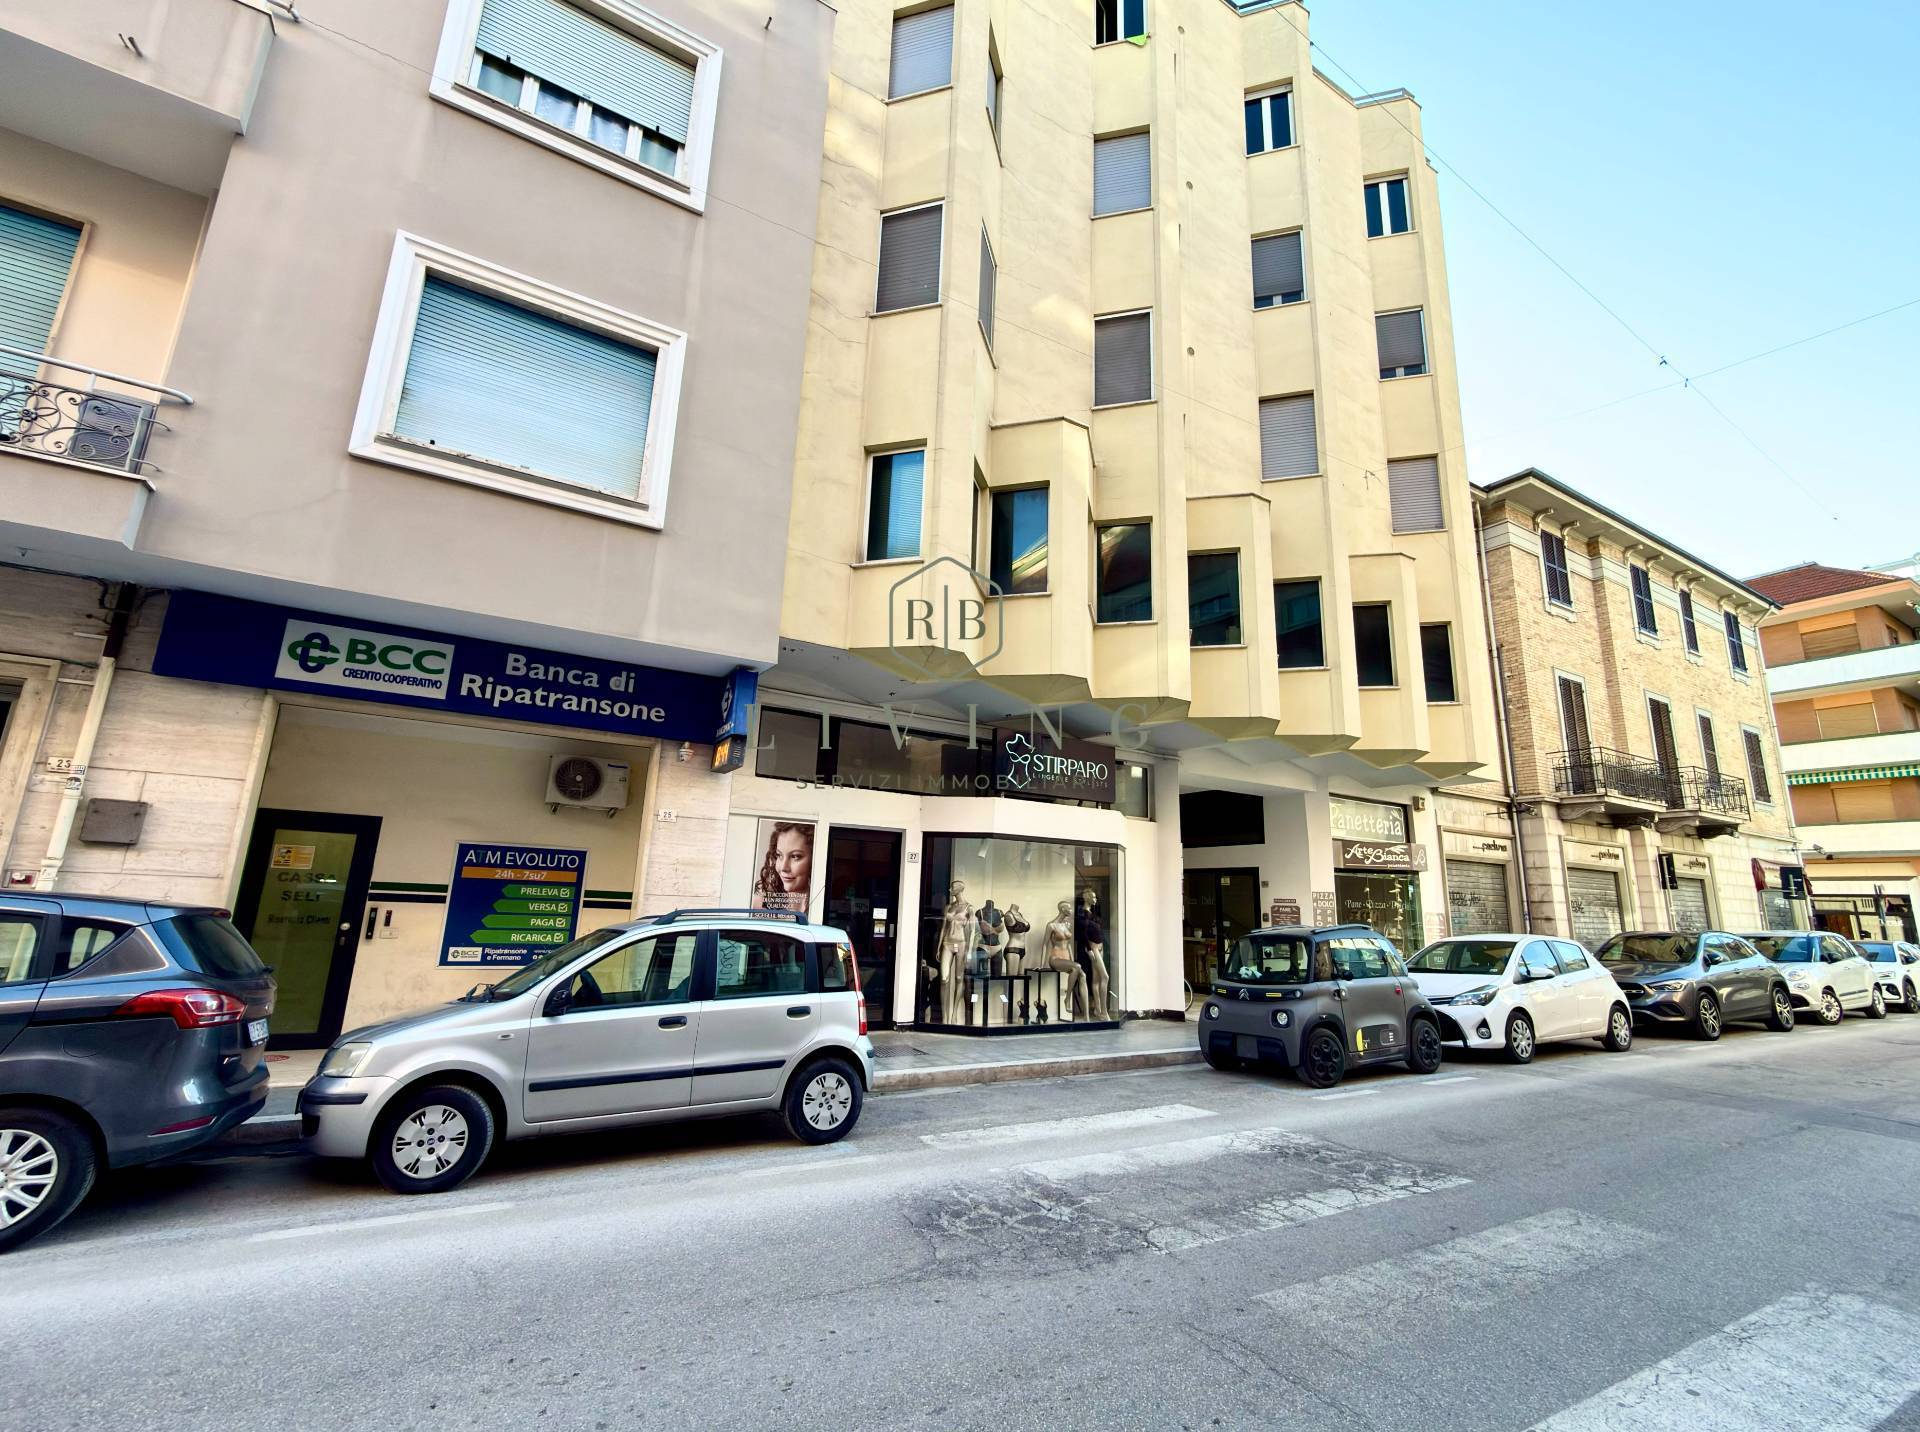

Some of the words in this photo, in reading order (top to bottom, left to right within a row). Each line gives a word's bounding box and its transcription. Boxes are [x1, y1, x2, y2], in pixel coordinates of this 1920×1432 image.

[345, 638, 447, 675] BCC
[505, 652, 600, 689] Banca
[609, 669, 636, 693] di
[343, 667, 382, 683] CREDITO
[382, 673, 443, 690] COOPERATIVO
[460, 673, 666, 723] Ripatransone
[57, 759, 72, 769] 23
[1033, 753, 1108, 781] STIRPARO
[663, 811, 672, 819] 25
[1329, 804, 1403, 836] Panetteria
[465, 849, 501, 865] ATM
[506, 851, 579, 869] EVOLUTO
[1345, 843, 1374, 859] Arte
[1365, 849, 1410, 865] Bianca
[495, 869, 514, 879] 24h
[523, 871, 547, 881] 7su7
[520, 887, 559, 896] PRELEVA
[1312, 892, 1334, 900] PIZZA
[528, 902, 556, 912] VERSA
[1317, 900, 1335, 908] DOLCI
[1345, 901, 1362, 909] Pane
[530, 918, 554, 927] PAGA
[511, 933, 552, 943] RICARICA
[484, 947, 528, 955] Ripatransone
